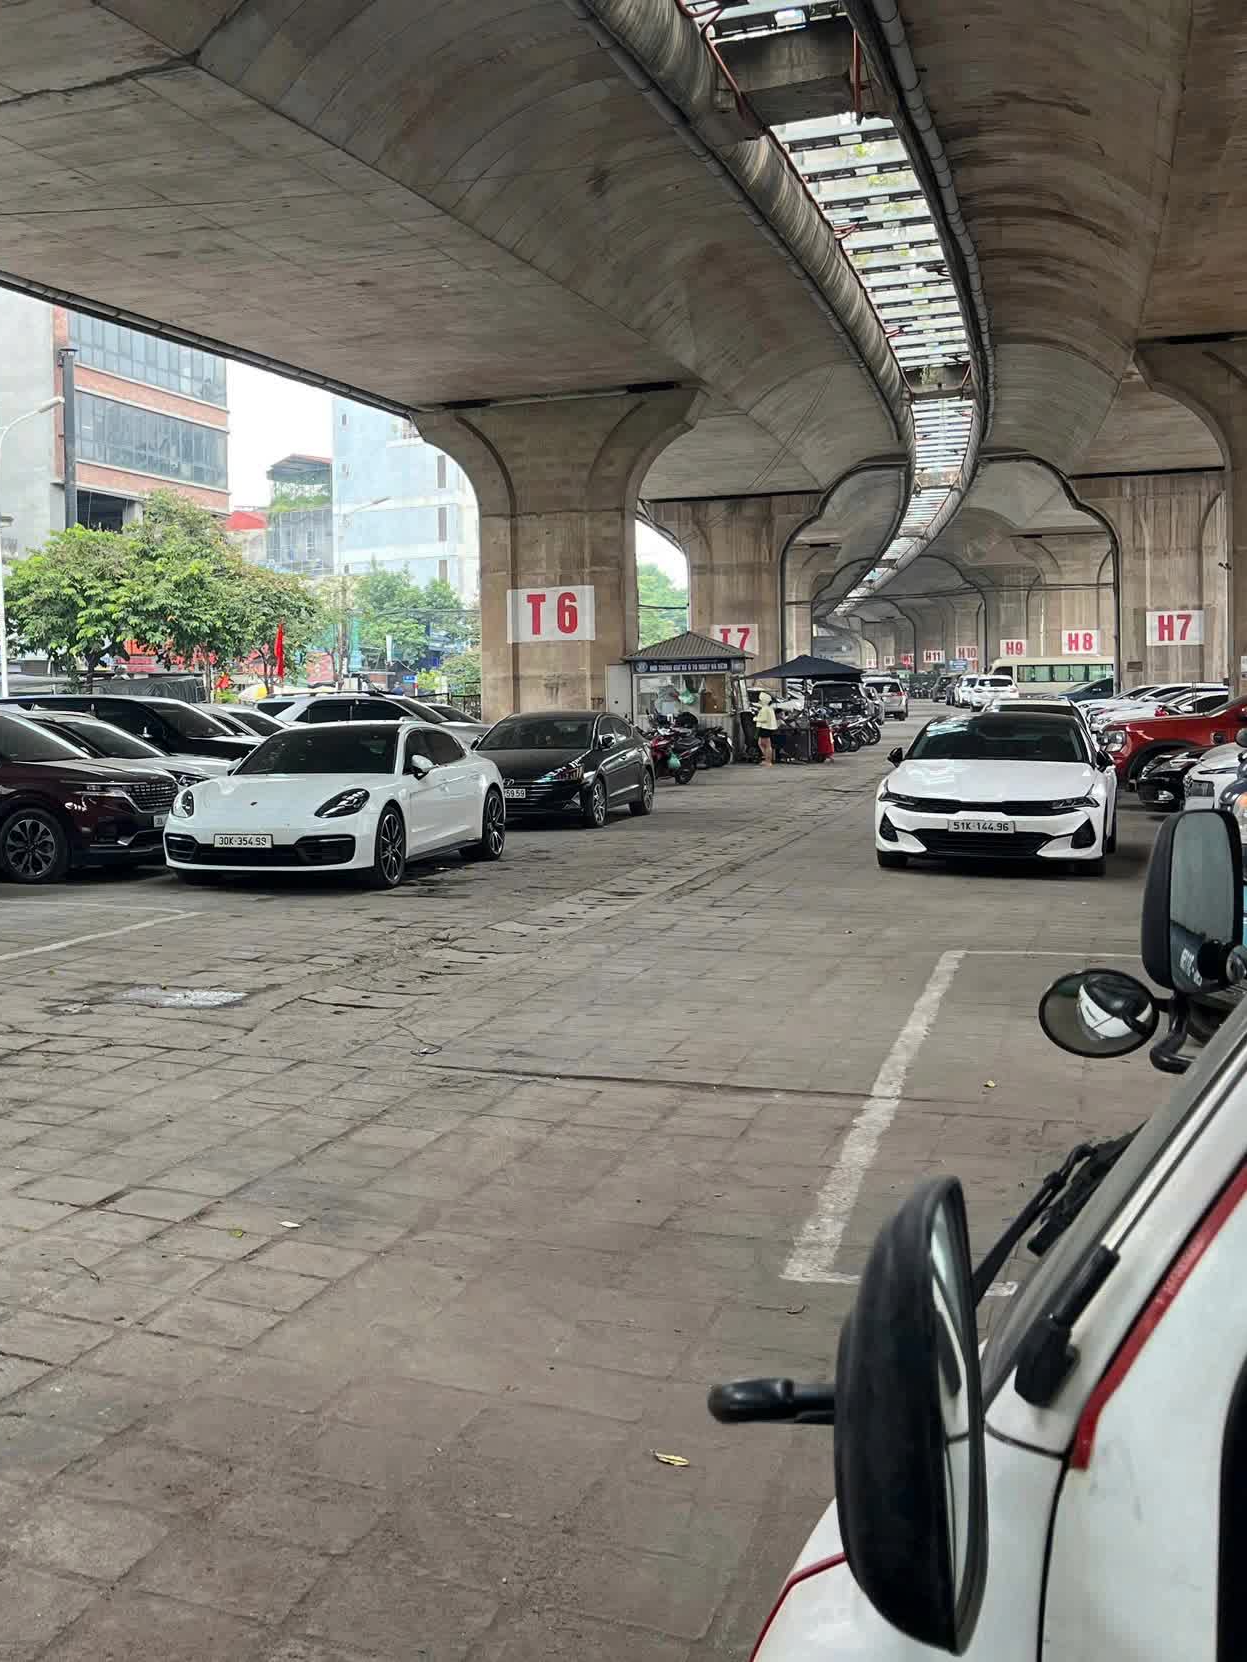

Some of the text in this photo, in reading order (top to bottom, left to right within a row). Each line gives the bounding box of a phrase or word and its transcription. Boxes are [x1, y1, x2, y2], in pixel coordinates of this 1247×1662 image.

[1158, 614, 1192, 641] H7
[1006, 641, 1023, 656] H9
[1068, 632, 1093, 651] H8
[925, 651, 941, 661] H11
[958, 647, 976, 659] H10
